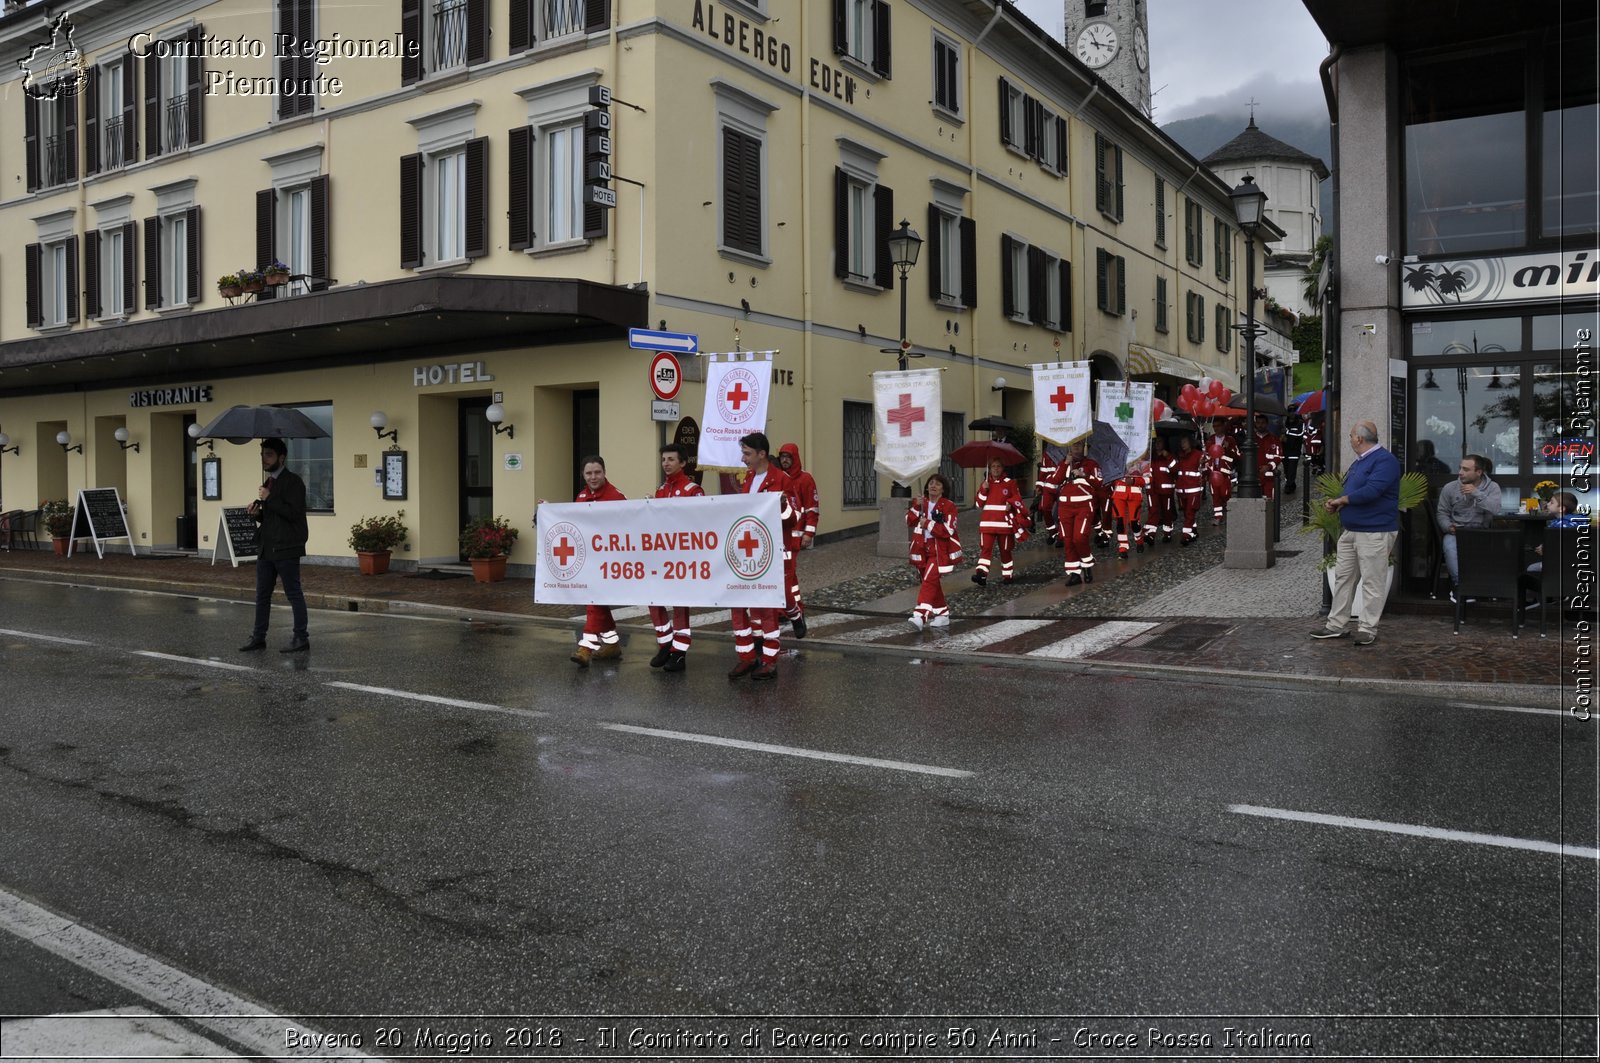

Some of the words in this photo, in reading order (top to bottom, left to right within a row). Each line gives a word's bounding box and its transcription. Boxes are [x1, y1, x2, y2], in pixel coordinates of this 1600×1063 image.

[692, 0, 791, 74] ALBERGO
[810, 57, 854, 105] EDEN
[600, 88, 610, 178] EDEN
[593, 189, 615, 204] HOTEL
[413, 361, 493, 386] HOTEL
[128, 386, 210, 407] RISTORANTE
[1541, 444, 1594, 457] OPEN
[591, 534, 635, 551] C.R.I.
[642, 531, 718, 551] BAVENO
[599, 561, 645, 580] 1968
[663, 561, 711, 580] 2018
[742, 559, 757, 573] 50
